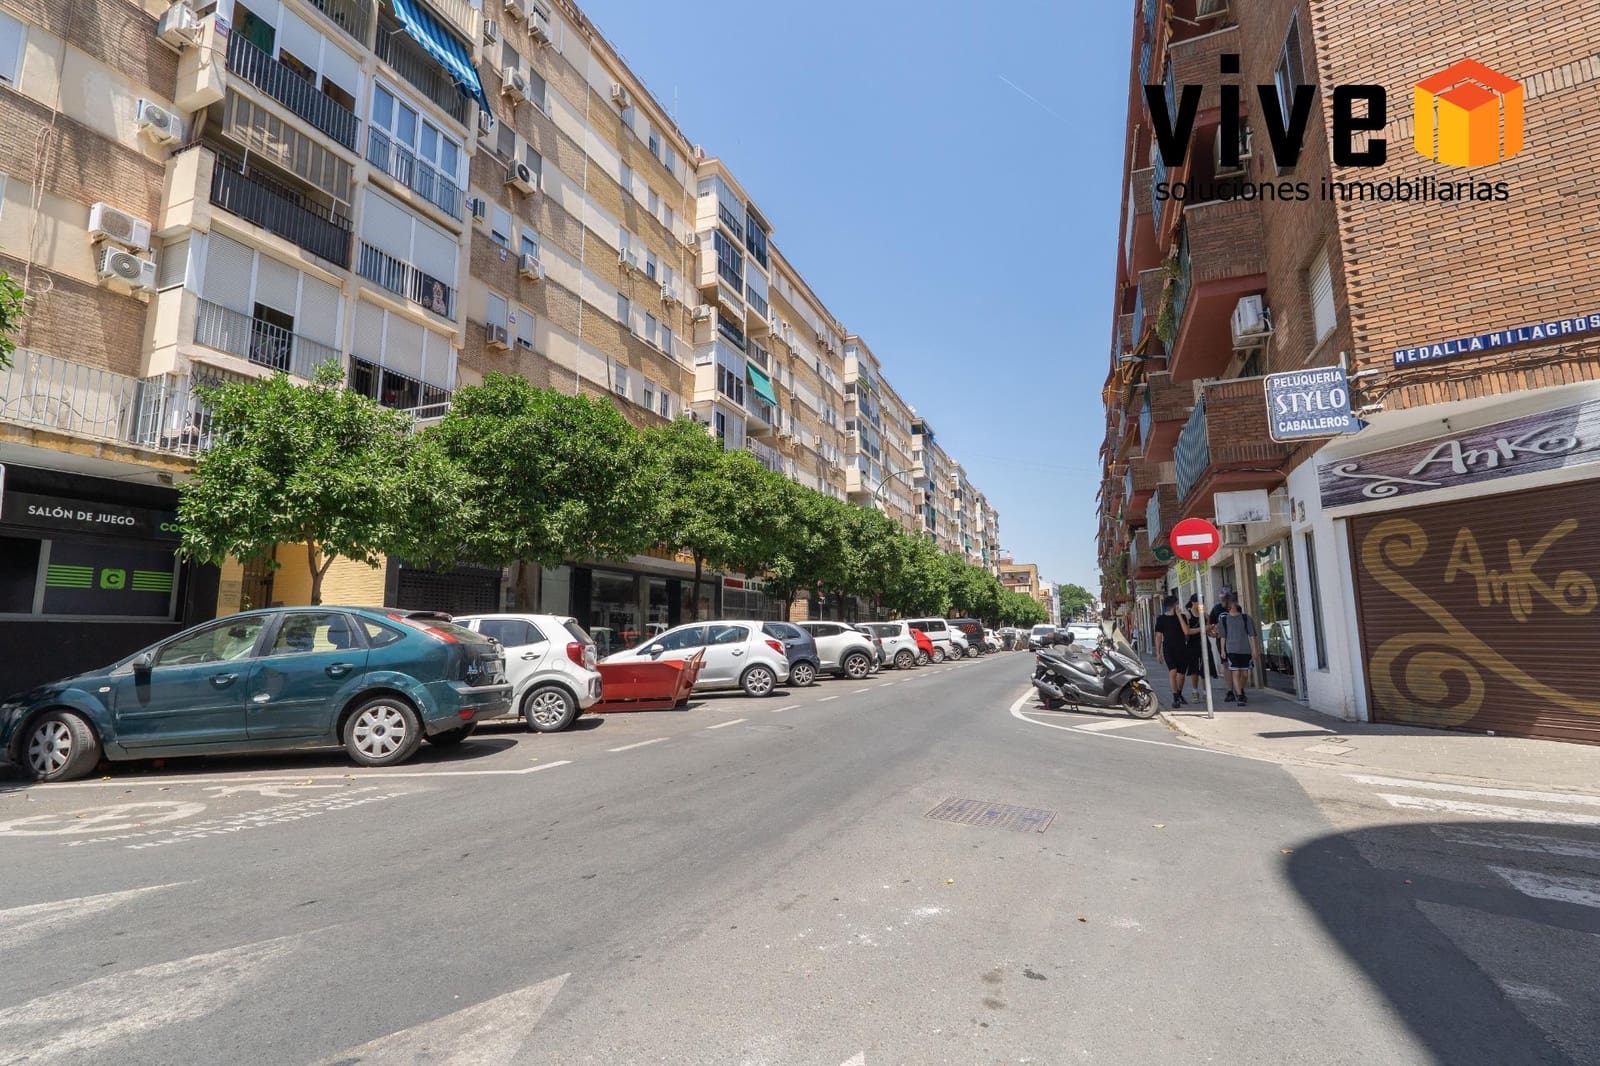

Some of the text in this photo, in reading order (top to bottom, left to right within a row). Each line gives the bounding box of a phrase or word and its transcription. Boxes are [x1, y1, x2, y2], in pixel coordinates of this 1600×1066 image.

[1395, 314, 1600, 363] MEDALLA MILAGROS
[1273, 370, 1343, 388] PELUQUERIA
[1276, 388, 1346, 415] STYLO
[1278, 415, 1349, 432] CABALLEROS
[27, 505, 136, 526] SALÓN DE JUEGO
[106, 573, 120, 585] C
